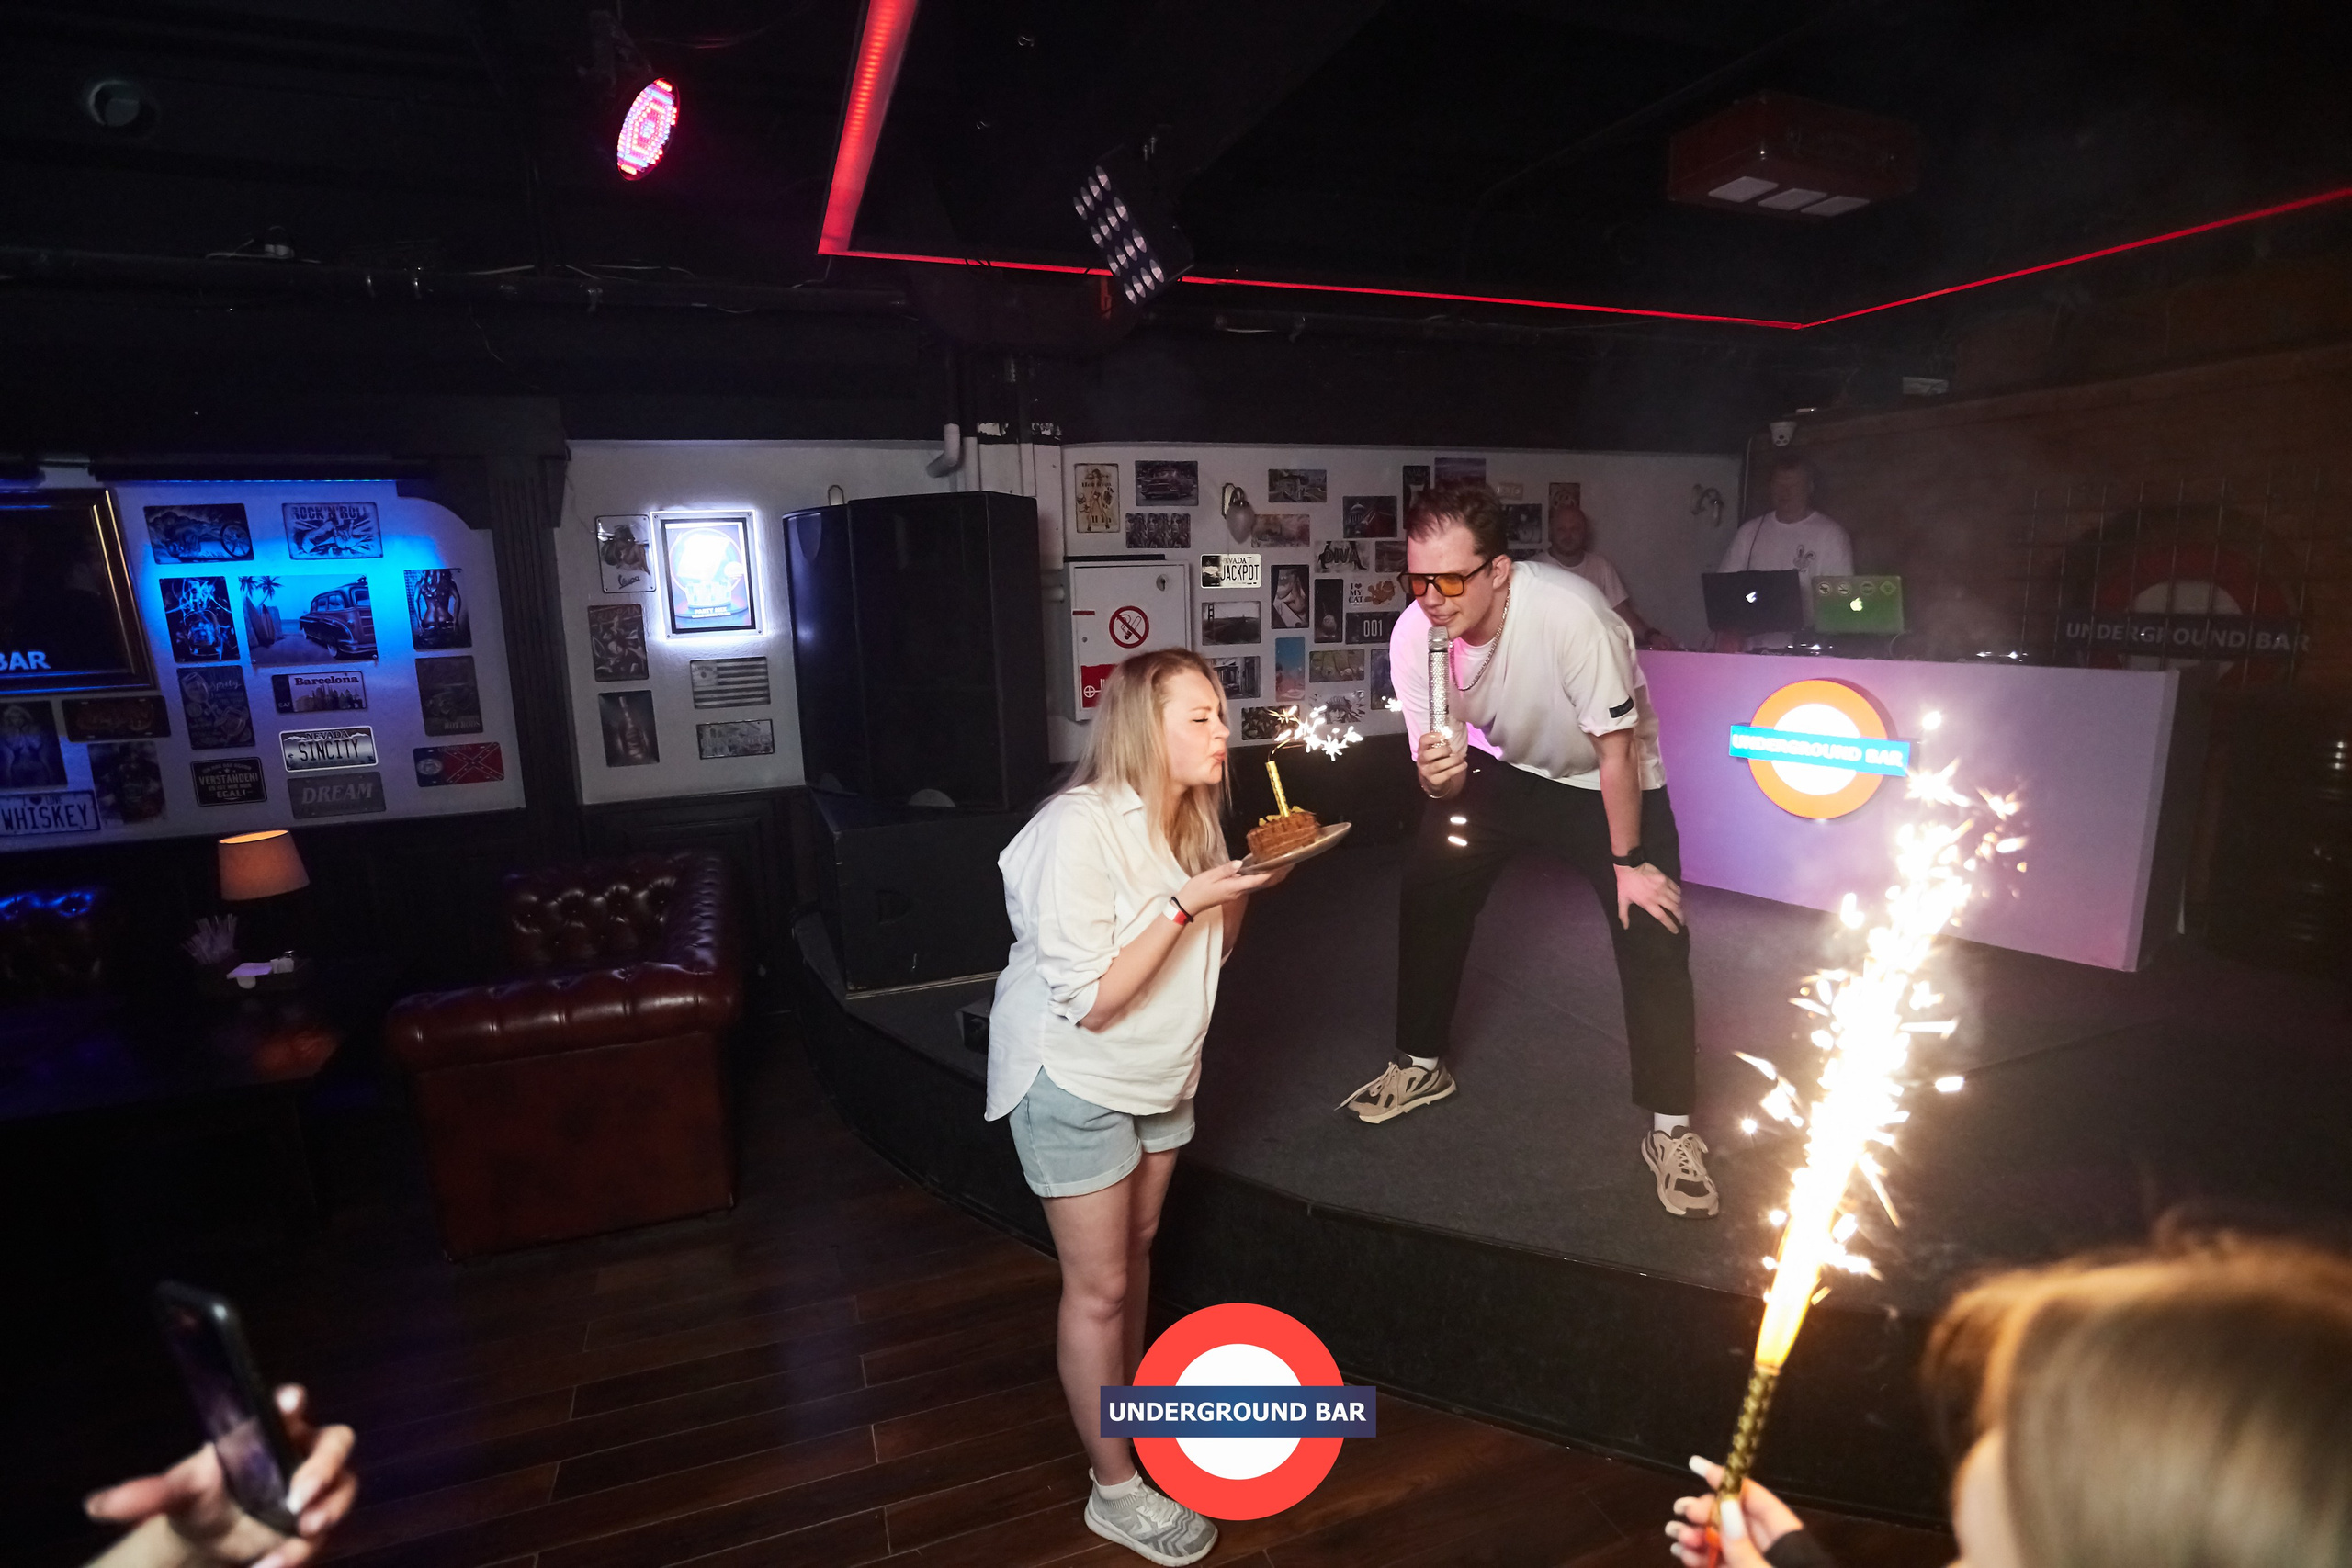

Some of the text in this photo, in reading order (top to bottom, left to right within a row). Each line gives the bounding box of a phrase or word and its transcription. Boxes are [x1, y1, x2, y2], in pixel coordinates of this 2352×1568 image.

[1325, 547, 1359, 563] DIVA
[1220, 564, 1260, 581] JACKPOT
[1363, 619, 1383, 637] 001
[2255, 632, 2310, 651] BAR
[294, 675, 359, 687] Barcelona
[305, 730, 350, 740] NEVADA
[299, 739, 359, 761] SINCITY
[1732, 733, 1905, 768] UNDERGROUND BAR
[198, 772, 259, 786] VERSTANDEN!
[216, 789, 246, 798] EGAL!
[301, 782, 374, 805] DREAM
[2, 803, 88, 831] WHISKEY
